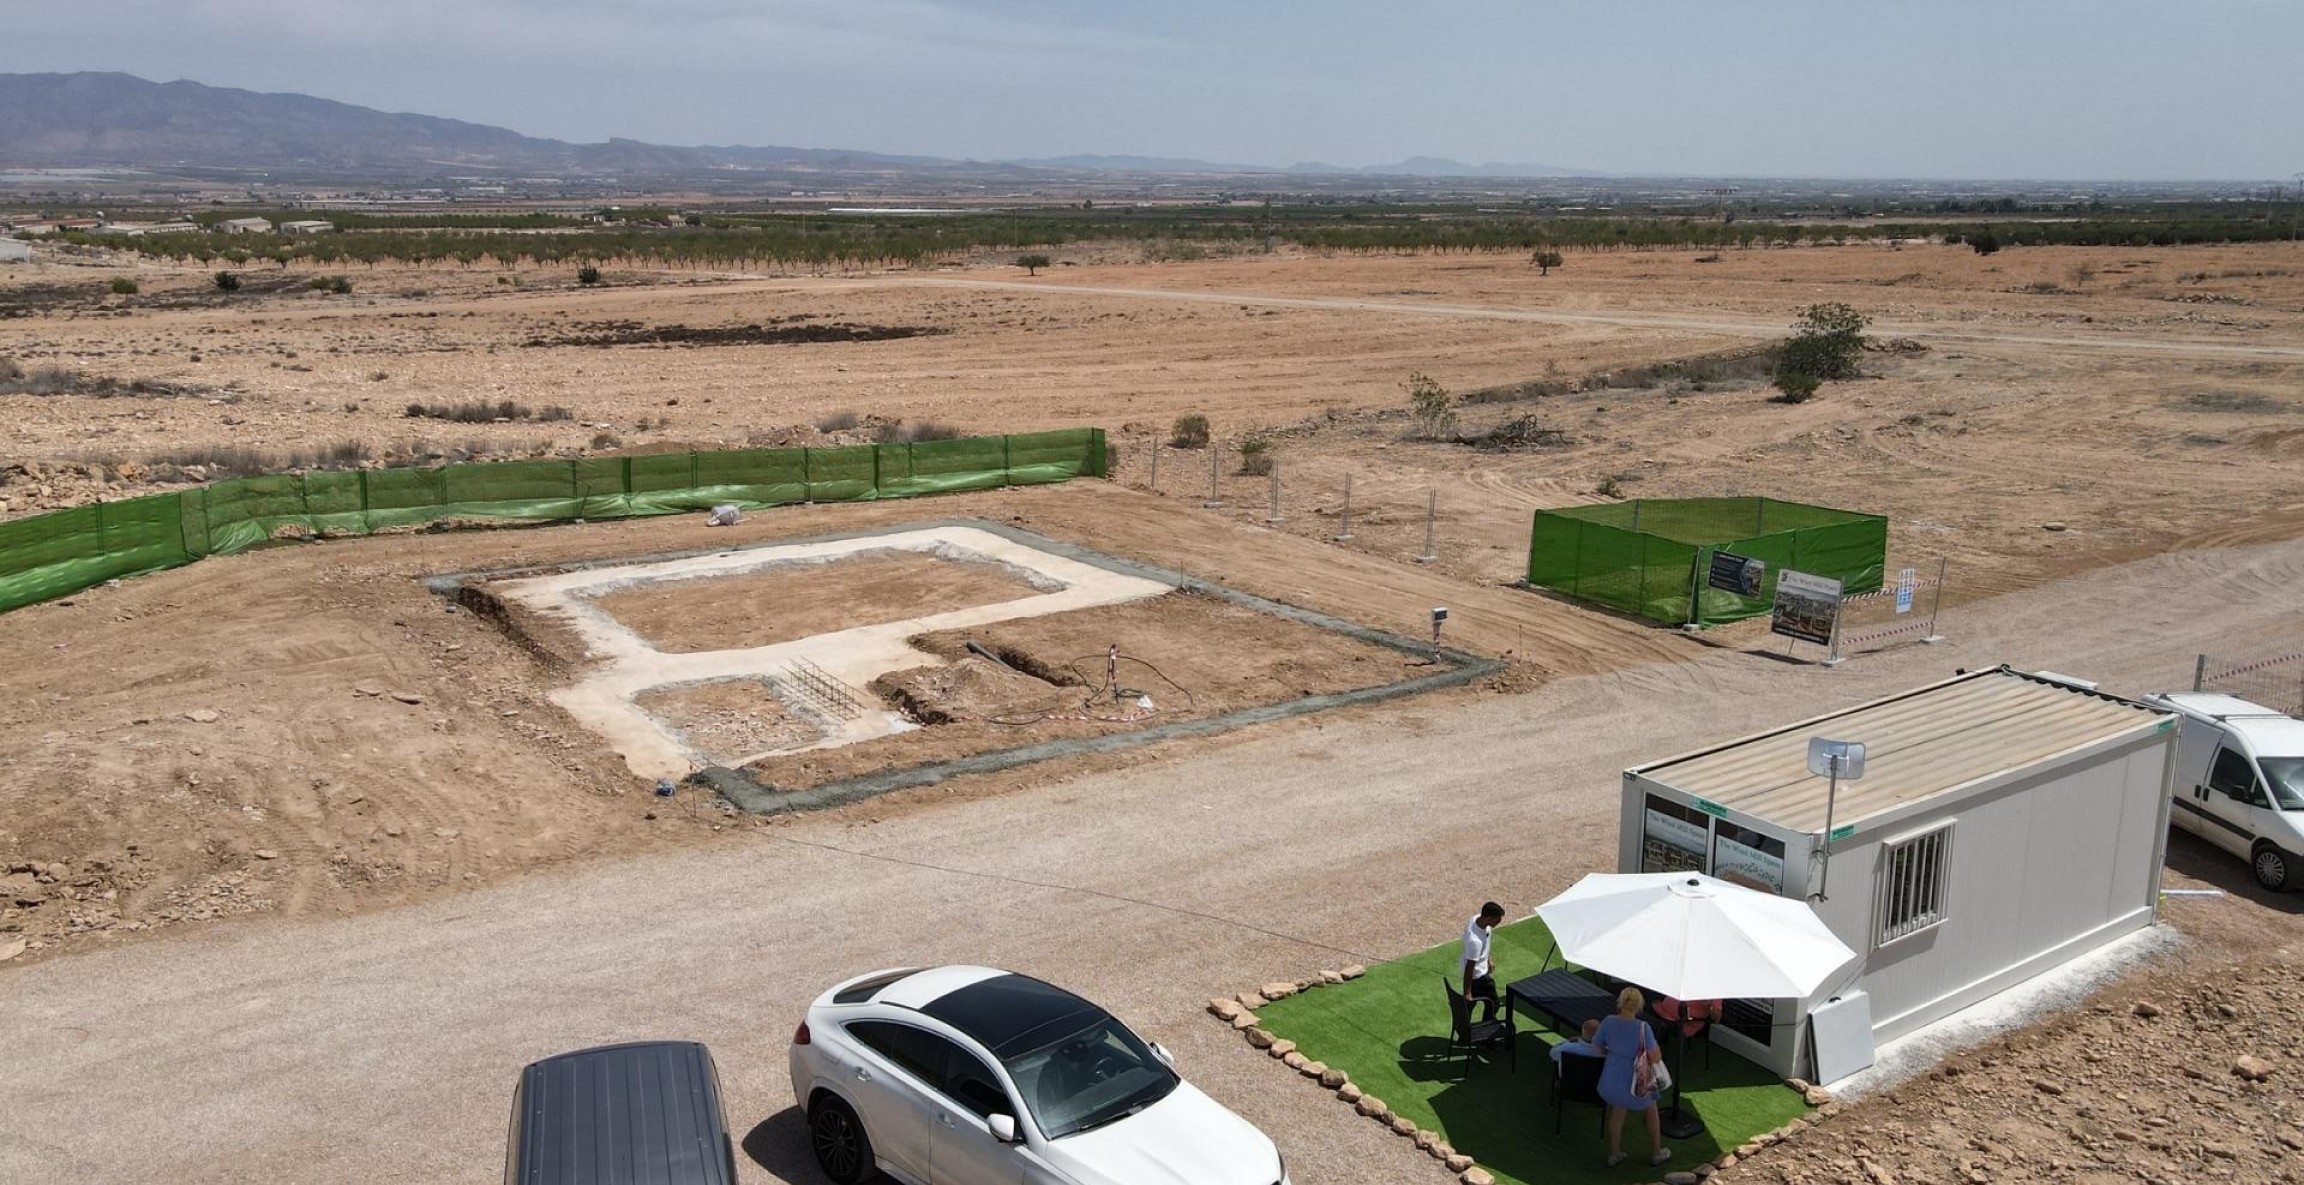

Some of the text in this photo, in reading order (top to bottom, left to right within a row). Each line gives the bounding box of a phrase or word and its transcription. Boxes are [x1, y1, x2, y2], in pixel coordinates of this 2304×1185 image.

[1648, 809, 1659, 822] The
[1660, 816, 1675, 828] Wind
[1719, 839, 1731, 850] The
[1732, 843, 1748, 857] Wind
[1750, 850, 1763, 862] Mill
